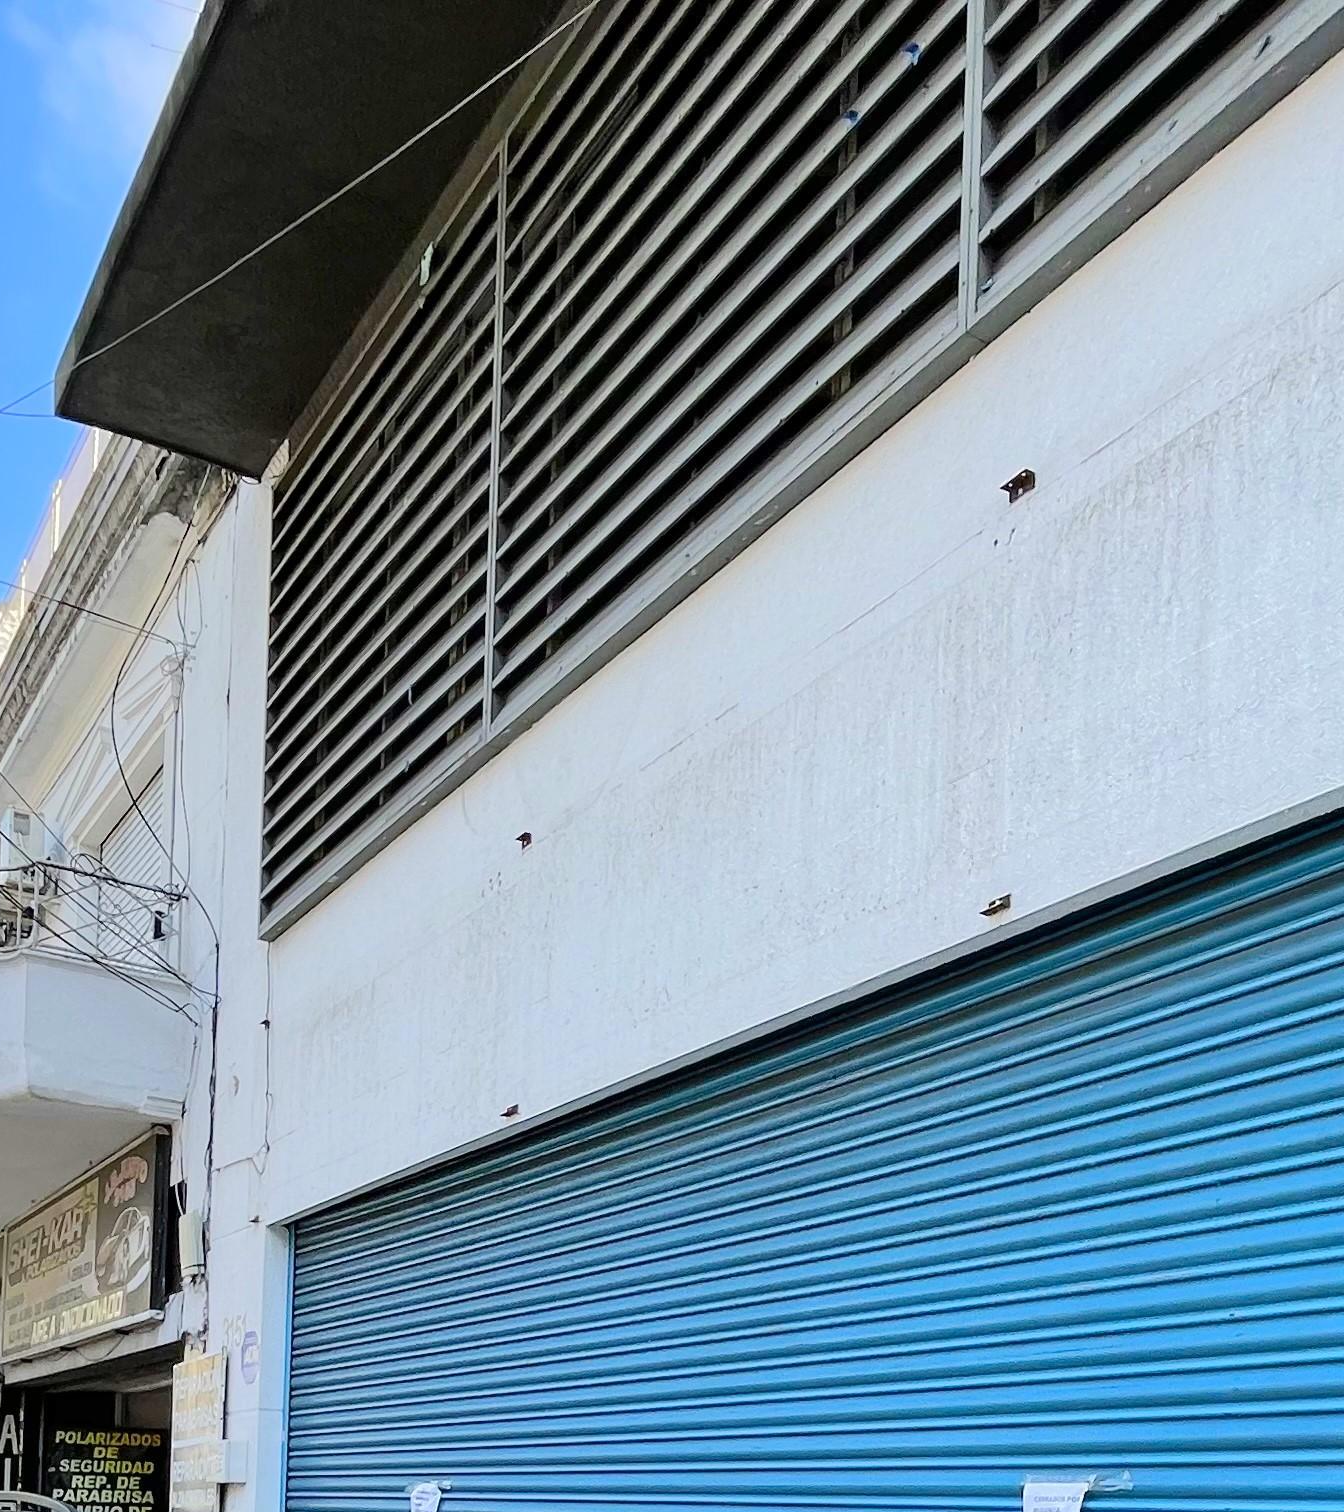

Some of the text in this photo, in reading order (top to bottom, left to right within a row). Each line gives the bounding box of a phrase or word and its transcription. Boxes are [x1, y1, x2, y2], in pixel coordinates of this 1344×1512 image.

[49, 1290, 124, 1341] AONDICIONADO
[56, 1430, 161, 1447] POLARIZADOS
[93, 1446, 119, 1459] DE
[59, 1459, 155, 1475] SEGURIDAD
[71, 1475, 141, 1490] REP. DE
[52, 1488, 155, 1504] PARABRISA
